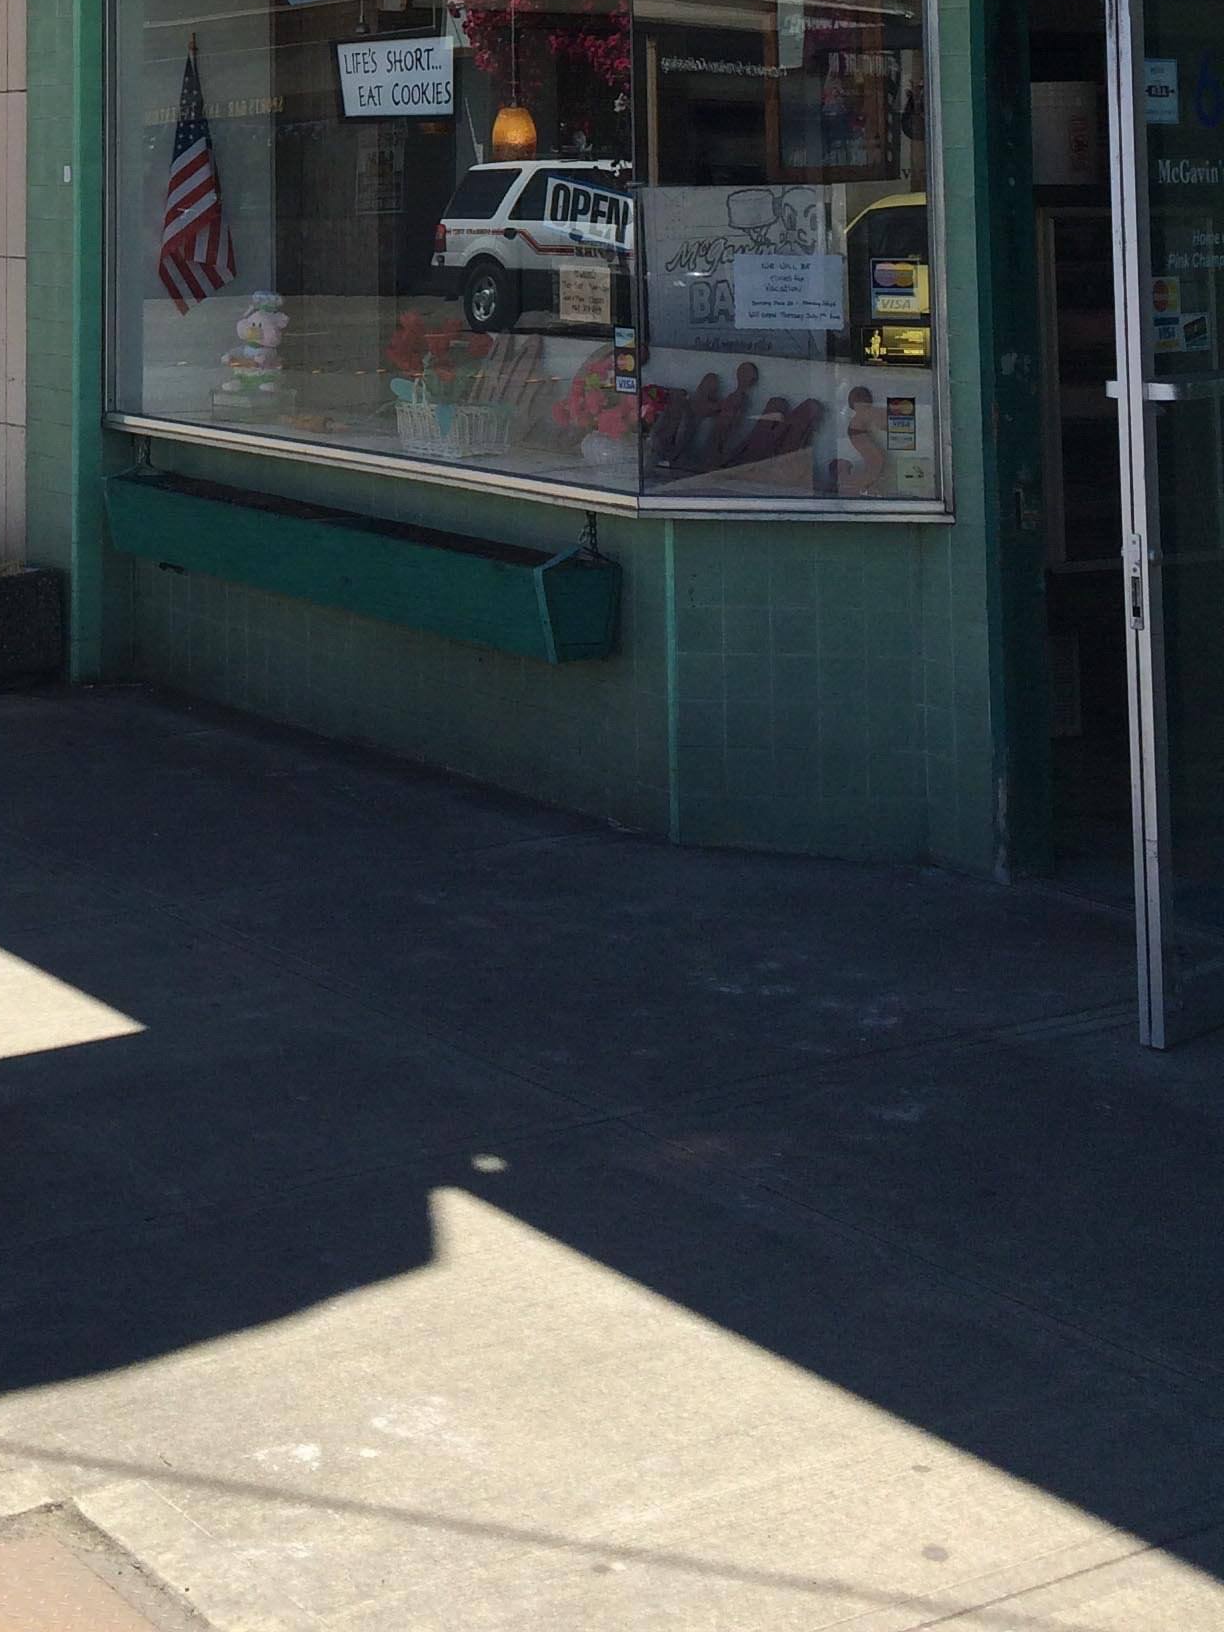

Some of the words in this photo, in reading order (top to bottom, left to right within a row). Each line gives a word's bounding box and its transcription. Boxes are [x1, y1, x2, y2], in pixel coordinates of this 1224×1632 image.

[344, 48, 377, 74] LIFE'S
[386, 48, 442, 73] SHORT...
[358, 85, 383, 107] EAT
[391, 81, 452, 106] COOKIES
[1158, 159, 1224, 184] McGavin'
[550, 182, 633, 244] OPEN
